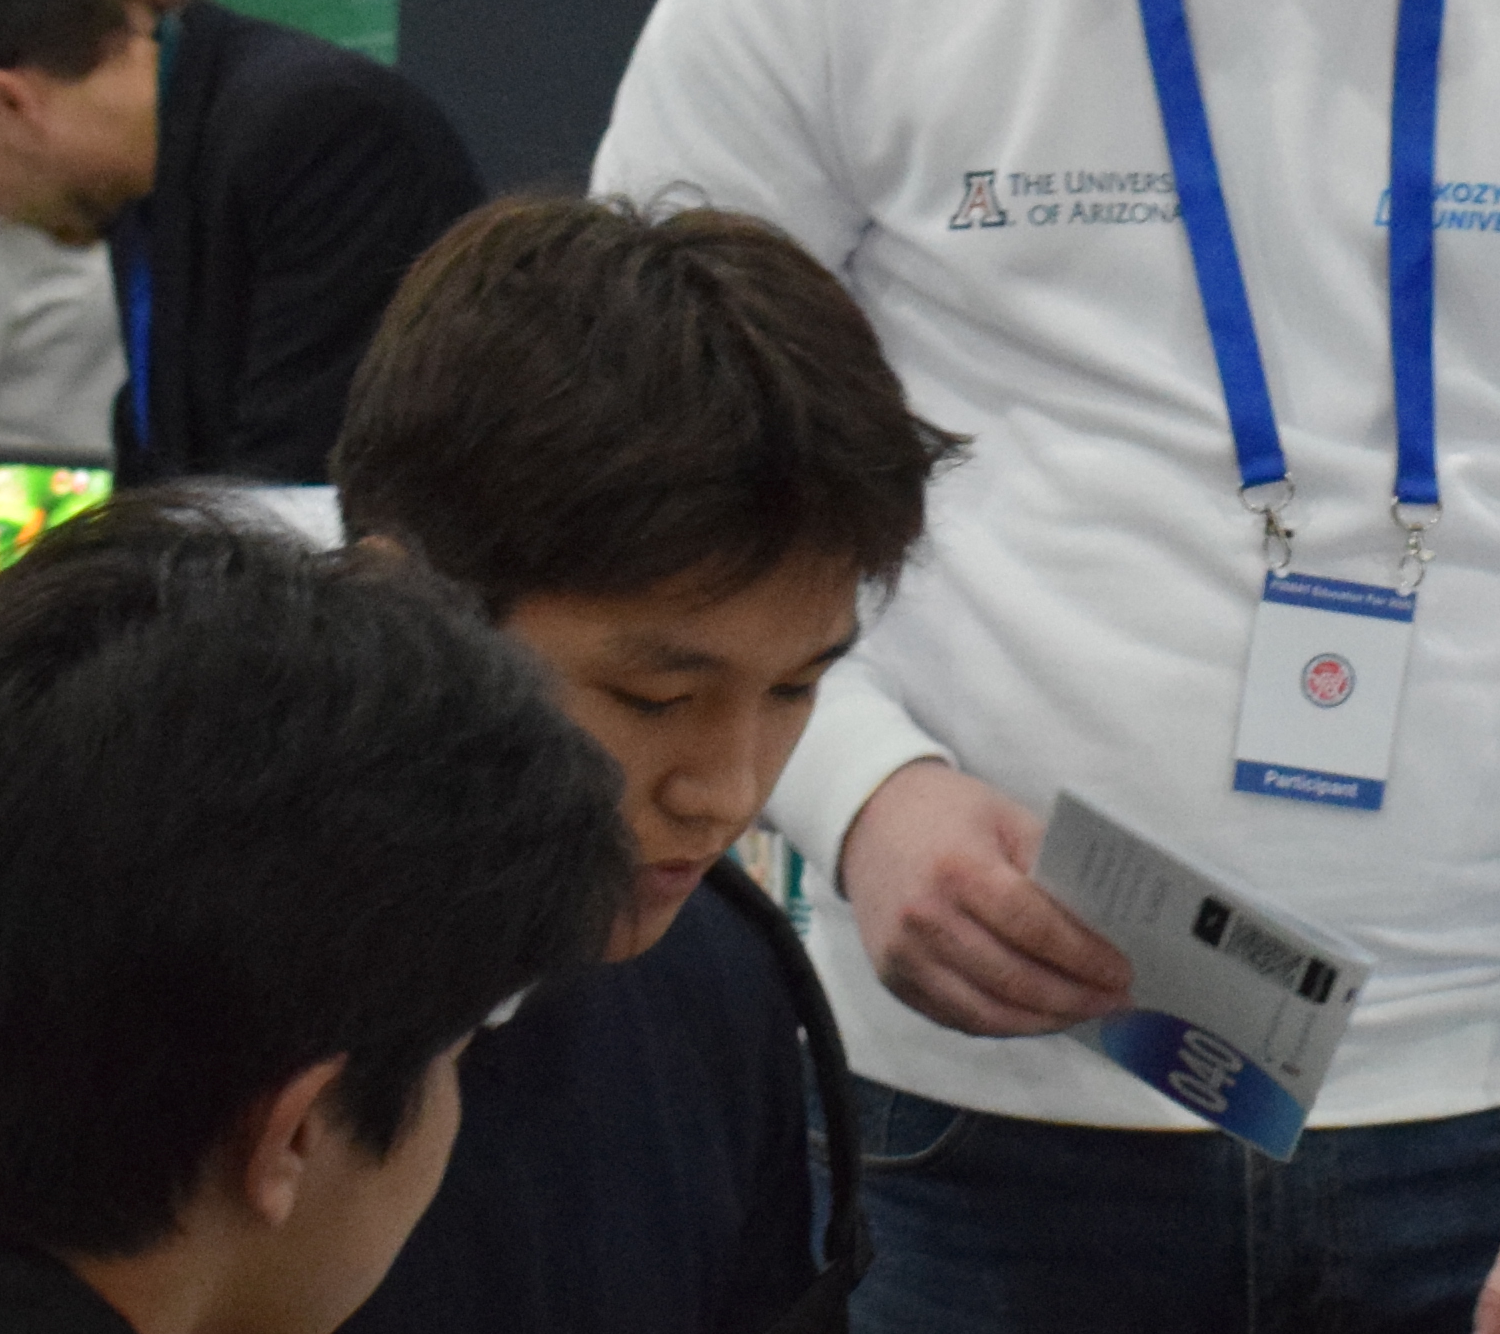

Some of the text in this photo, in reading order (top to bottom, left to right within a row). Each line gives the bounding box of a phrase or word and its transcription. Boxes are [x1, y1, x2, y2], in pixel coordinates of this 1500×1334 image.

[1008, 170, 1175, 197] THE UNIVERS
[1027, 203, 1060, 226] OF
[1263, 769, 1359, 799] Participant
